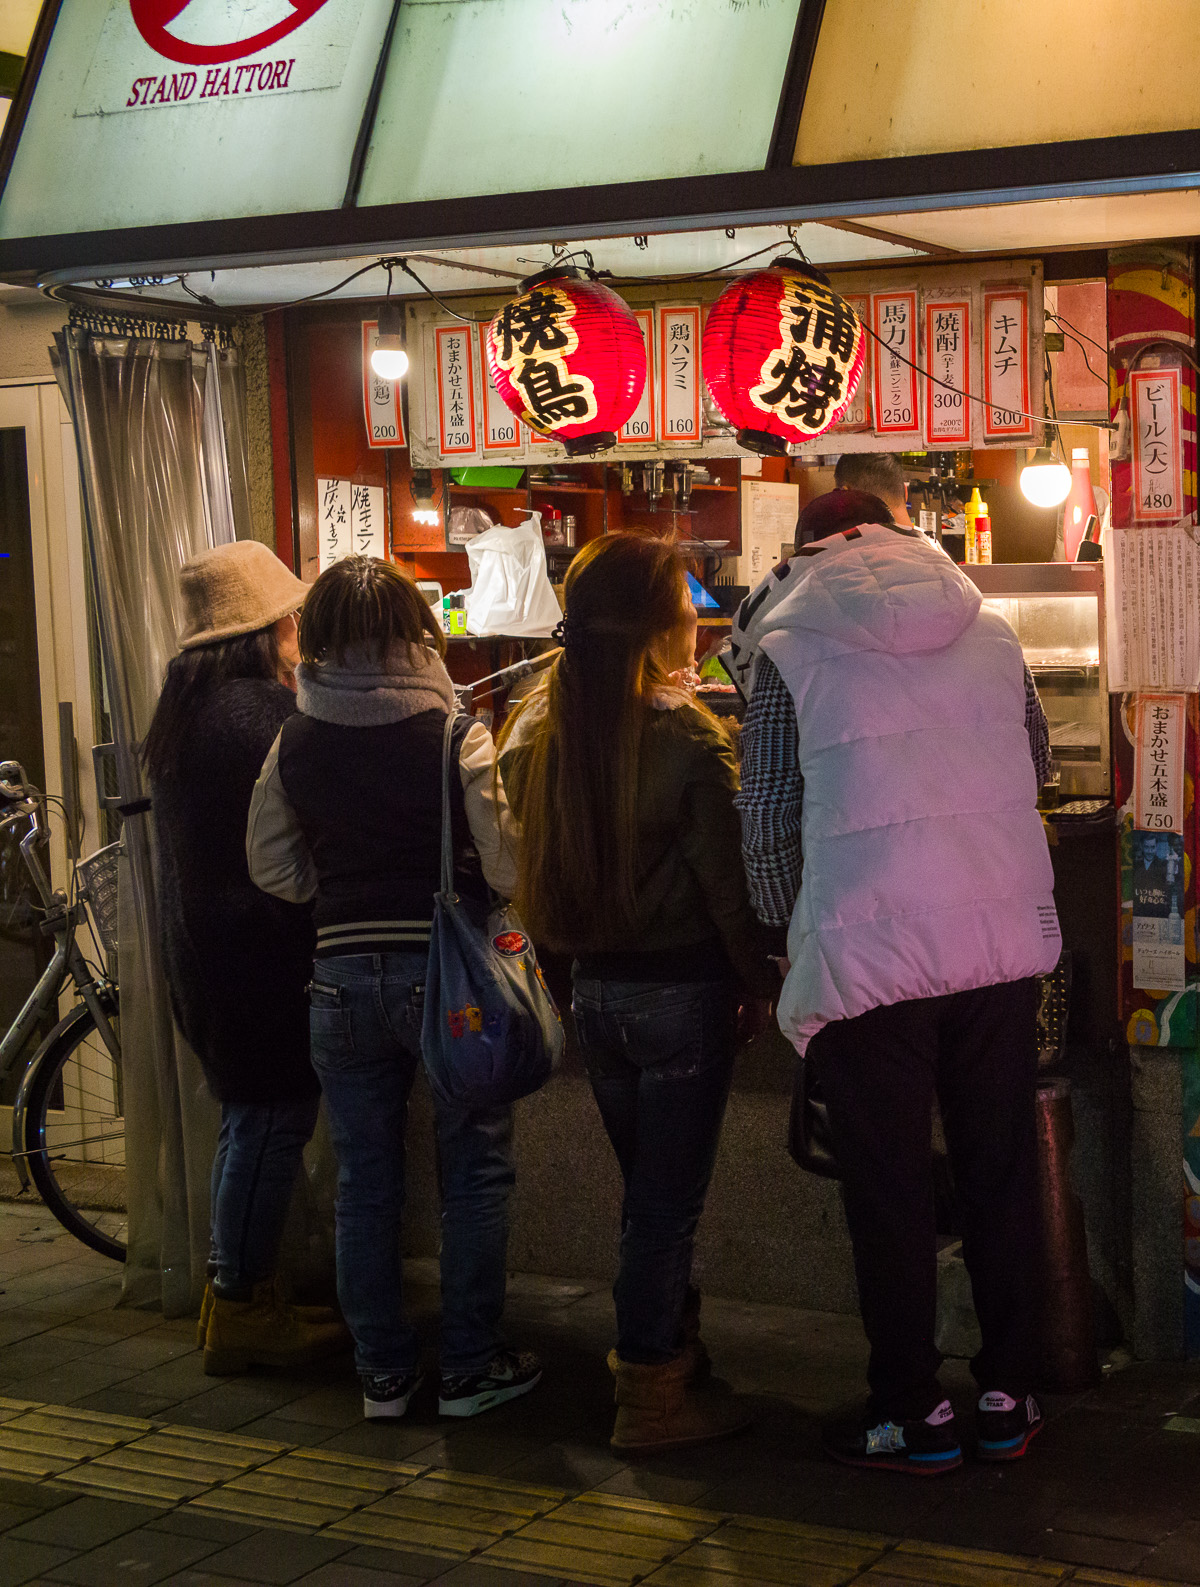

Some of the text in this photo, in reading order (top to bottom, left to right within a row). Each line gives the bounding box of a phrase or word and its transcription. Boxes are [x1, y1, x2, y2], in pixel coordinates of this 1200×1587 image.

[126, 58, 297, 107] STAND HATTORI
[994, 315, 1018, 376] キムチ
[497, 289, 589, 429] 焼鳥
[670, 323, 691, 390] 鶏ハラミ
[447, 337, 465, 427] おまかせ五本盛
[934, 393, 962, 408] 300
[883, 408, 911, 423] 250
[993, 411, 1021, 425] 300
[374, 425, 396, 438] 200
[625, 421, 649, 435] 160
[669, 419, 693, 432] 160
[1144, 384, 1169, 475] ビール(大)
[447, 432, 469, 445] 750
[491, 427, 514, 440] 160
[1143, 494, 1172, 509] 480
[1150, 706, 1170, 808] おまかせ五本盛
[1145, 813, 1174, 828] 750
